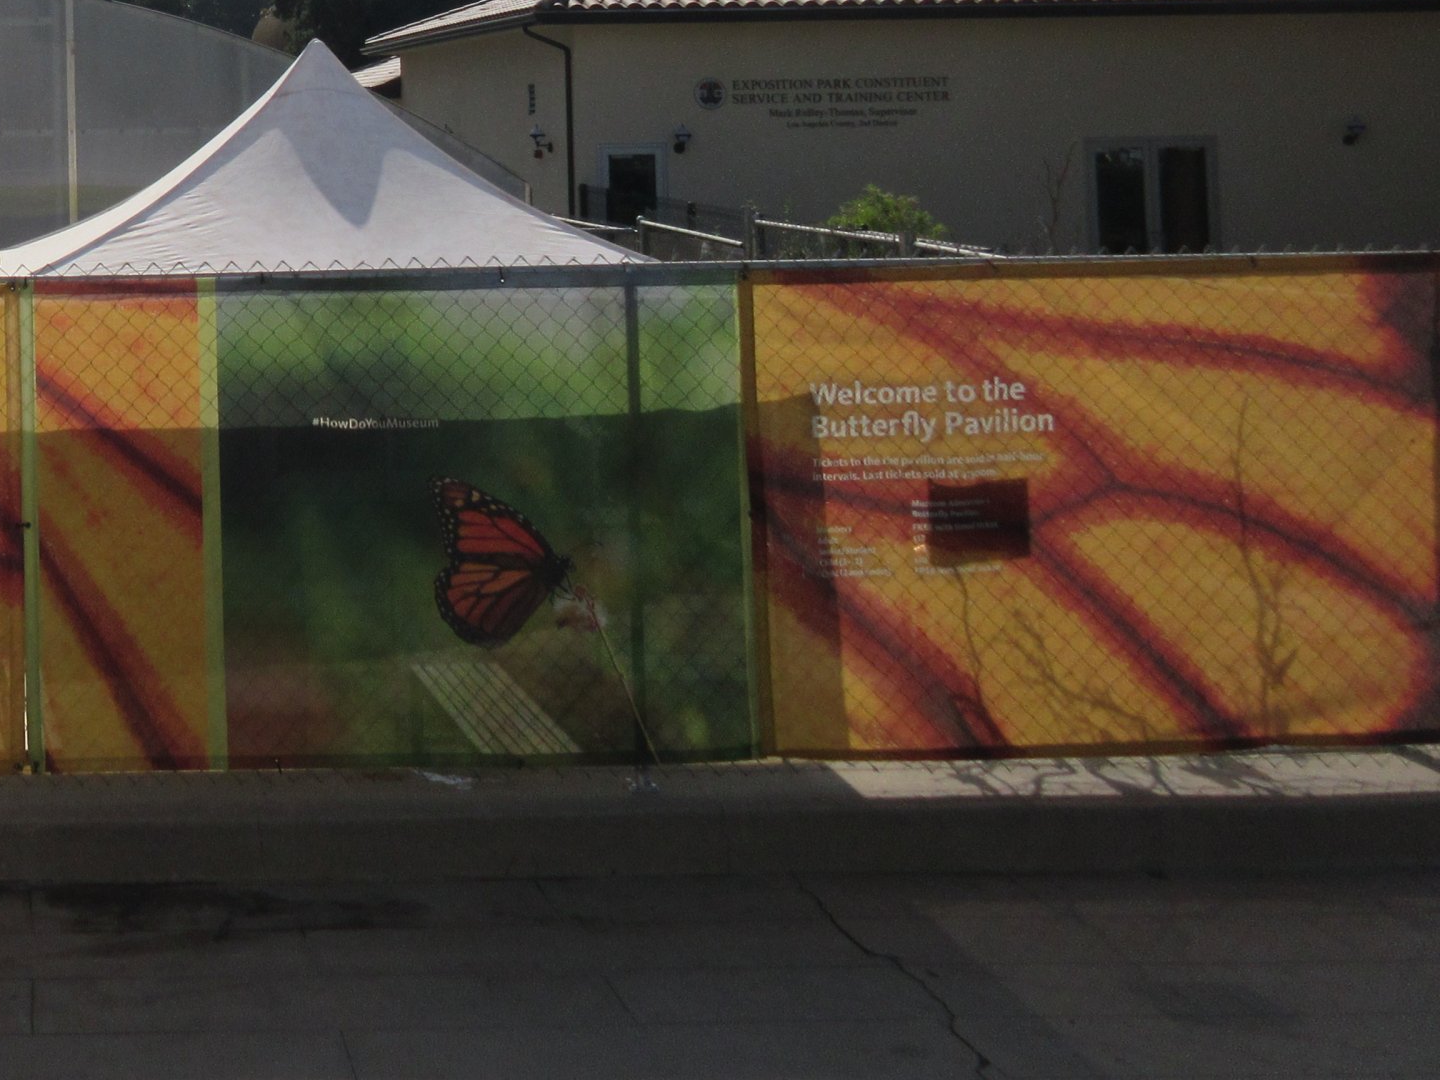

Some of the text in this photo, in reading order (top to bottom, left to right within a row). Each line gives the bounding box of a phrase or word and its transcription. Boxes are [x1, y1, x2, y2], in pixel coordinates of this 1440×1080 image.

[732, 76, 949, 91] EXPOSITION PARK CONSTITUENT
[732, 90, 951, 104] SERVICE AND TRAINING CENTER
[810, 376, 1026, 406] Welcome to the
[312, 416, 439, 430] #HowDoYouMuseum
[812, 408, 1055, 444] Butterfly Pavilion
[813, 456, 849, 467] Tickets
[850, 457, 861, 467] to
[863, 455, 881, 466] the
[862, 470, 883, 481] Last
[885, 469, 921, 480] tickets
[923, 468, 946, 479] sold
